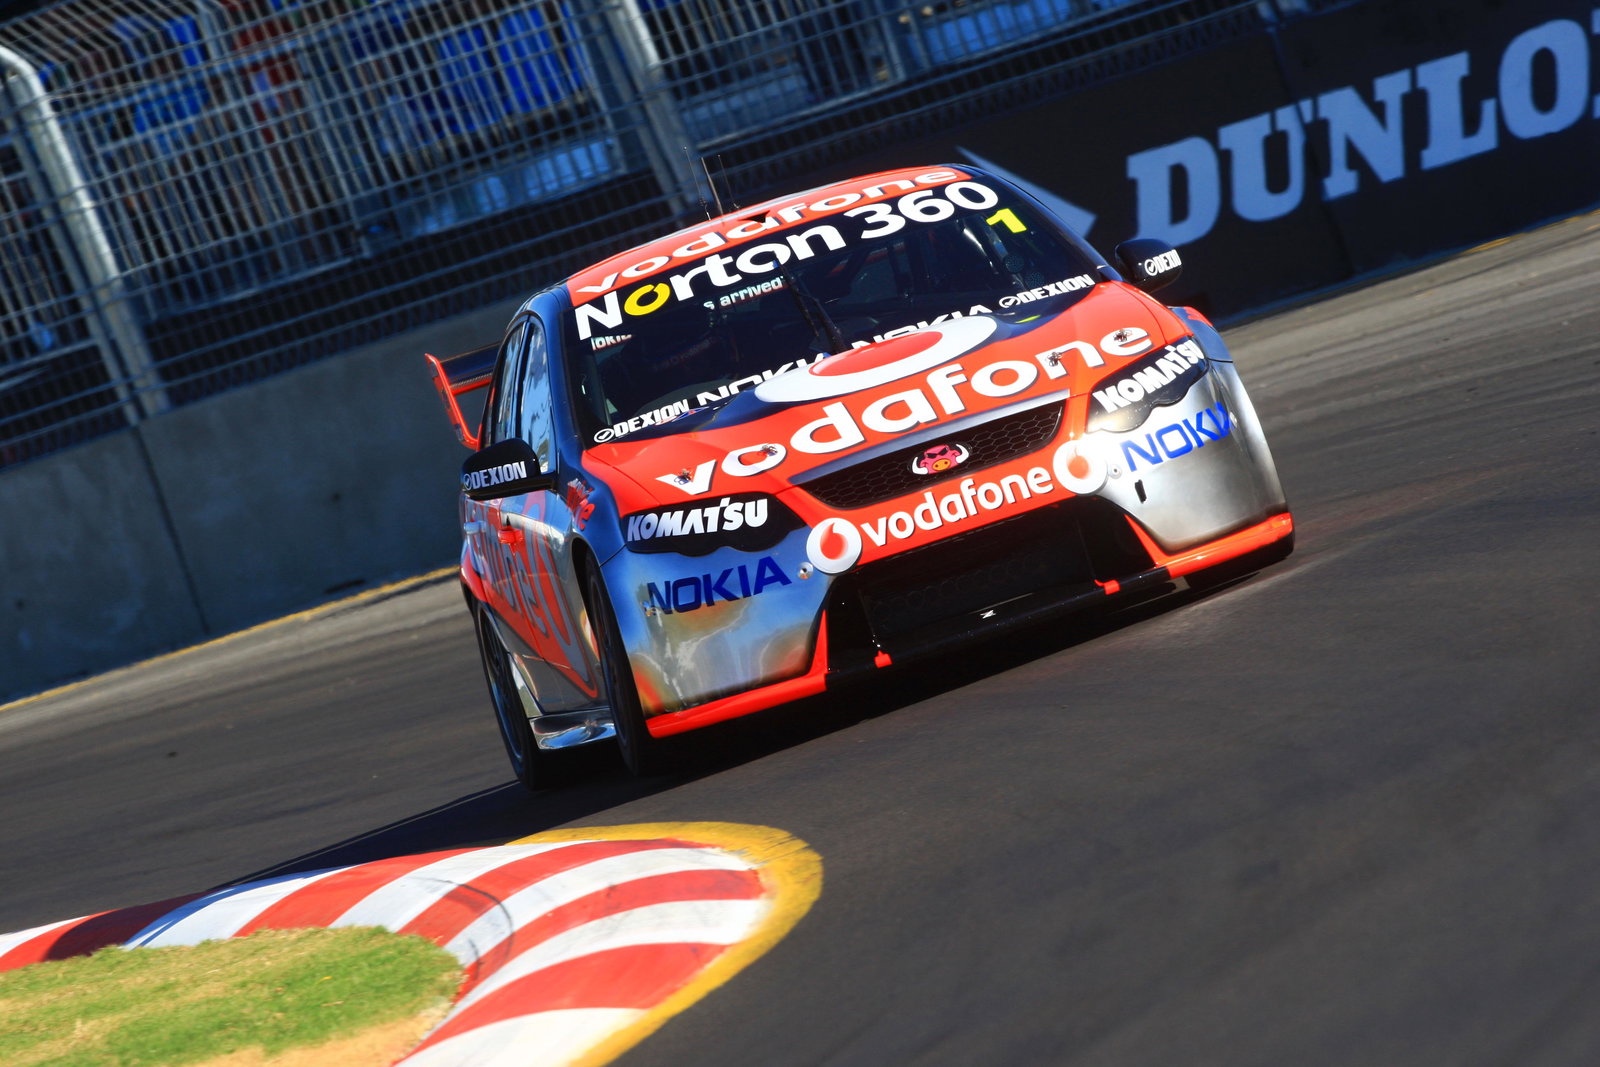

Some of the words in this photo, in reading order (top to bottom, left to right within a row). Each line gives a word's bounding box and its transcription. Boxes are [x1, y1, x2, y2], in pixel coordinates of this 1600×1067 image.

[1127, 9, 1600, 248] DUNLO
[576, 171, 958, 294] vodafone
[985, 208, 1028, 234] 1
[574, 224, 847, 341] Norton
[844, 181, 999, 239] 360
[1016, 273, 1096, 304] DEXION
[1092, 339, 1205, 414] KOMATSU
[613, 398, 691, 439] DEXION
[655, 326, 1153, 496] vodafone
[471, 460, 528, 491] DEXION
[859, 466, 1055, 547] vodafone
[626, 496, 769, 542] KOMATSU
[646, 555, 793, 616] NOKIA
